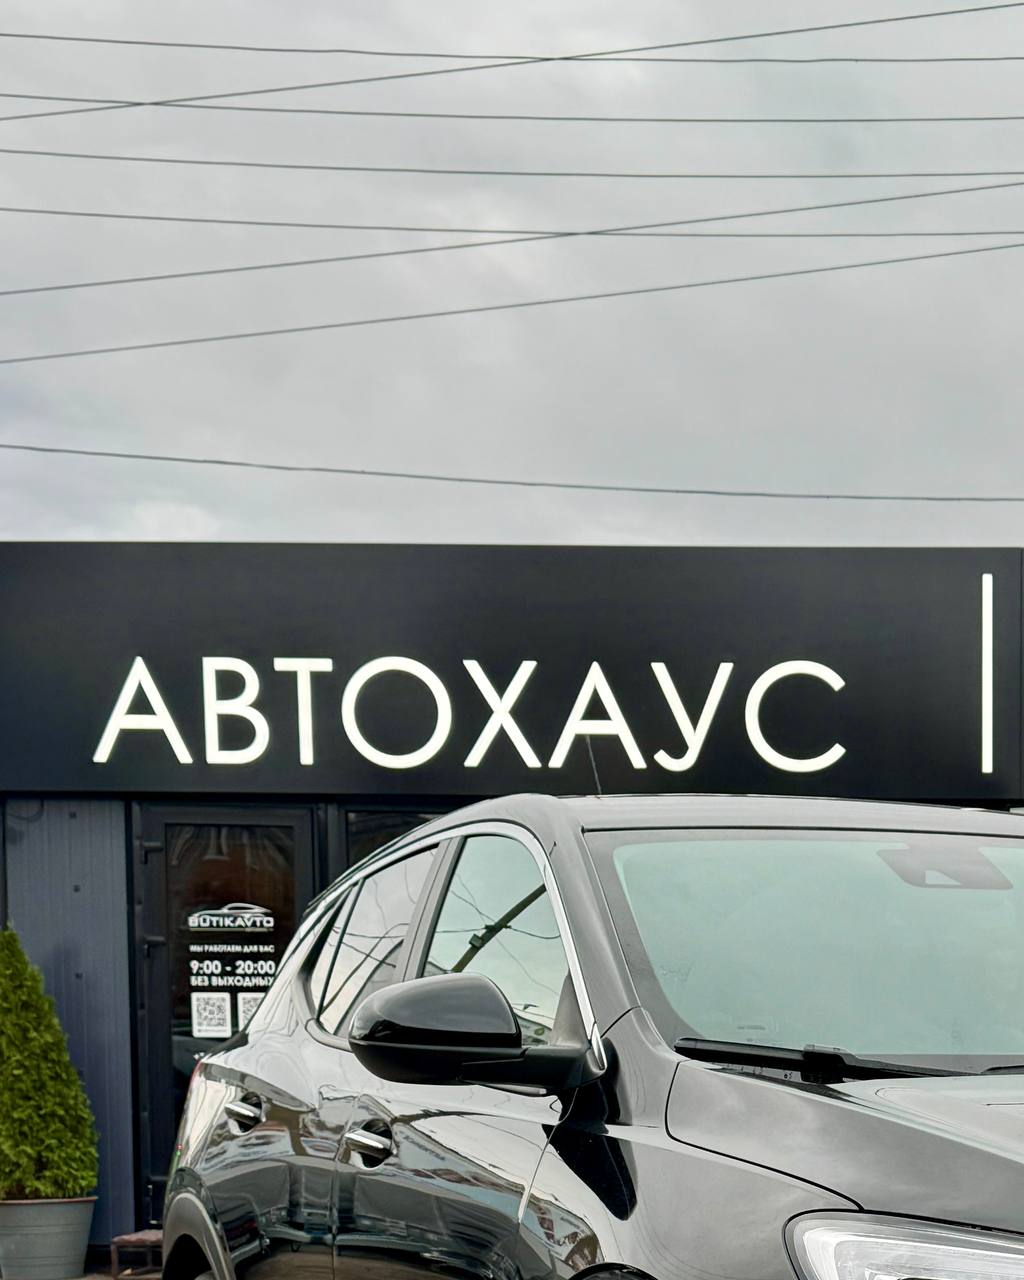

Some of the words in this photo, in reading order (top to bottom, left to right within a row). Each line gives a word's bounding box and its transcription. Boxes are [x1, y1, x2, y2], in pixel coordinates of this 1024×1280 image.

[92, 655, 847, 773] АВТОХАУС
[187, 916, 274, 928] BUTIKAVTO
[204, 945, 242, 953] РАБОТАЕМ
[259, 945, 275, 953] ВАС
[189, 960, 222, 974] 9:00
[235, 960, 276, 974] 20:00
[190, 976, 209, 986] БЕЗ
